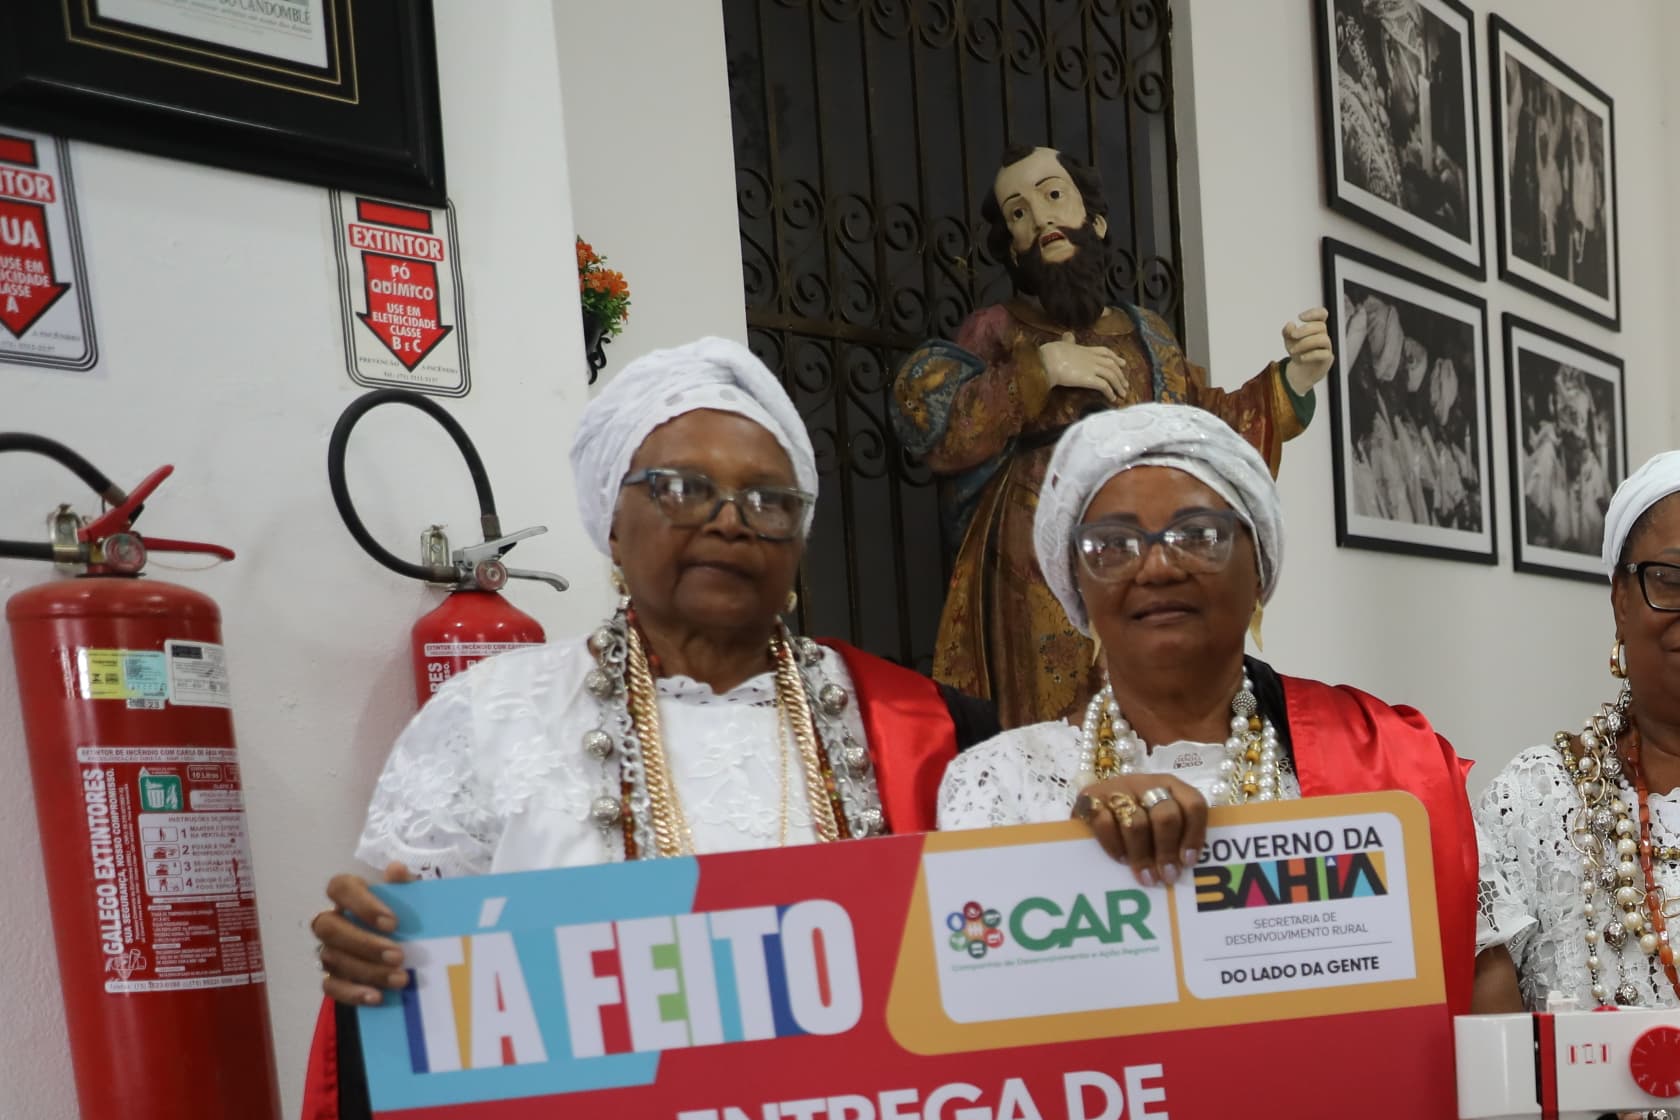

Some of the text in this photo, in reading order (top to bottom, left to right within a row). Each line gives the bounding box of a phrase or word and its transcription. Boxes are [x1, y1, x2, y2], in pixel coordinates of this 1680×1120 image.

[351, 226, 443, 260] EXTINTOR
[26, 259, 44, 273] EM
[390, 263, 411, 280] PÓ
[6, 297, 19, 313] A
[386, 302, 421, 317] USE EM
[372, 312, 437, 330] ELETRICIDADE
[390, 325, 422, 338] CLASSE
[392, 337, 402, 350] B
[412, 340, 422, 353] C
[112, 837, 126, 867] NOSSO
[182, 845, 190, 855] 2
[1197, 826, 1383, 864] GOVERNO DA
[82, 768, 125, 955] GALEGO EXTINTORES
[184, 861, 191, 872] 3
[185, 877, 193, 889] 4
[1193, 852, 1389, 912] BAHIA
[1009, 889, 1156, 951] CAR
[1254, 912, 1337, 929] SECRETARIA DE
[120, 917, 134, 944] SUA
[1225, 924, 1368, 946] DESENVOLVIMENTO RURAL
[1221, 956, 1380, 985] DO LADO DA GENTE
[400, 898, 548, 1073] TÁ
[555, 900, 863, 1060] FEITO
